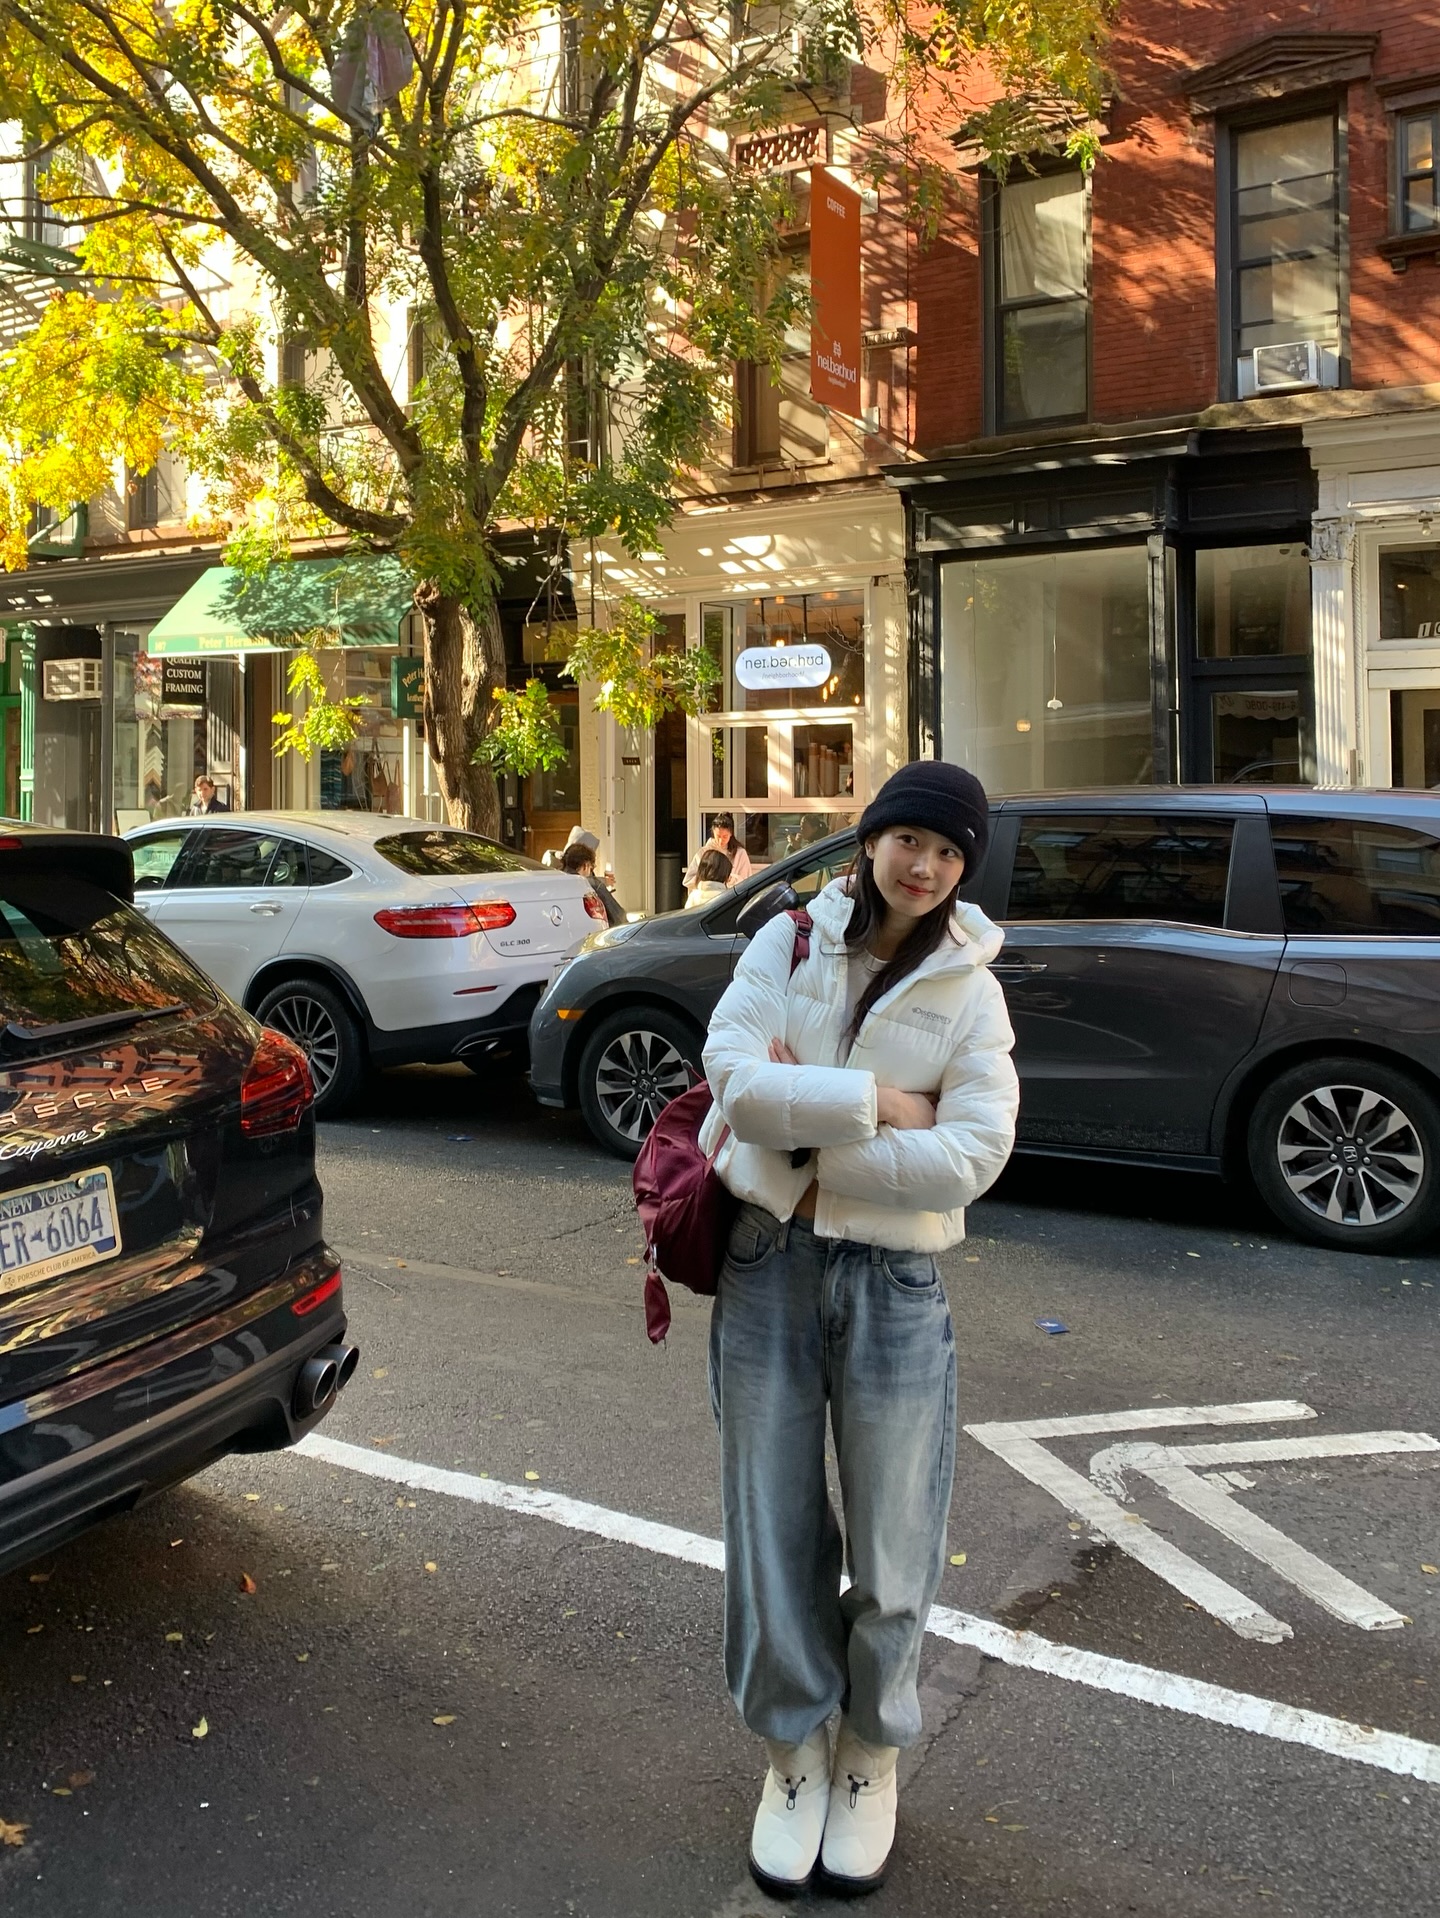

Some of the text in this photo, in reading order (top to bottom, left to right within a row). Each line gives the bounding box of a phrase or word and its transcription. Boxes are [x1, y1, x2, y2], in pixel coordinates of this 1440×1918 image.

[826, 196, 846, 219] COFFEE
[199, 636, 223, 649] Peter
[166, 668, 202, 680] CUSTOM
[402, 670, 417, 688] Peter
[165, 682, 203, 694] FRAMING
[516, 938, 531, 946] 300
[0, 1121, 107, 1162] Cayenne S
[1, 1182, 77, 1220] NEW YORK
[46, 1196, 104, 1253] 6064
[17, 1266, 46, 1283] PORSCHE
[46, 1262, 62, 1274] CLUB
[62, 1259, 70, 1268] OF
[71, 1251, 97, 1266] AMERICA
